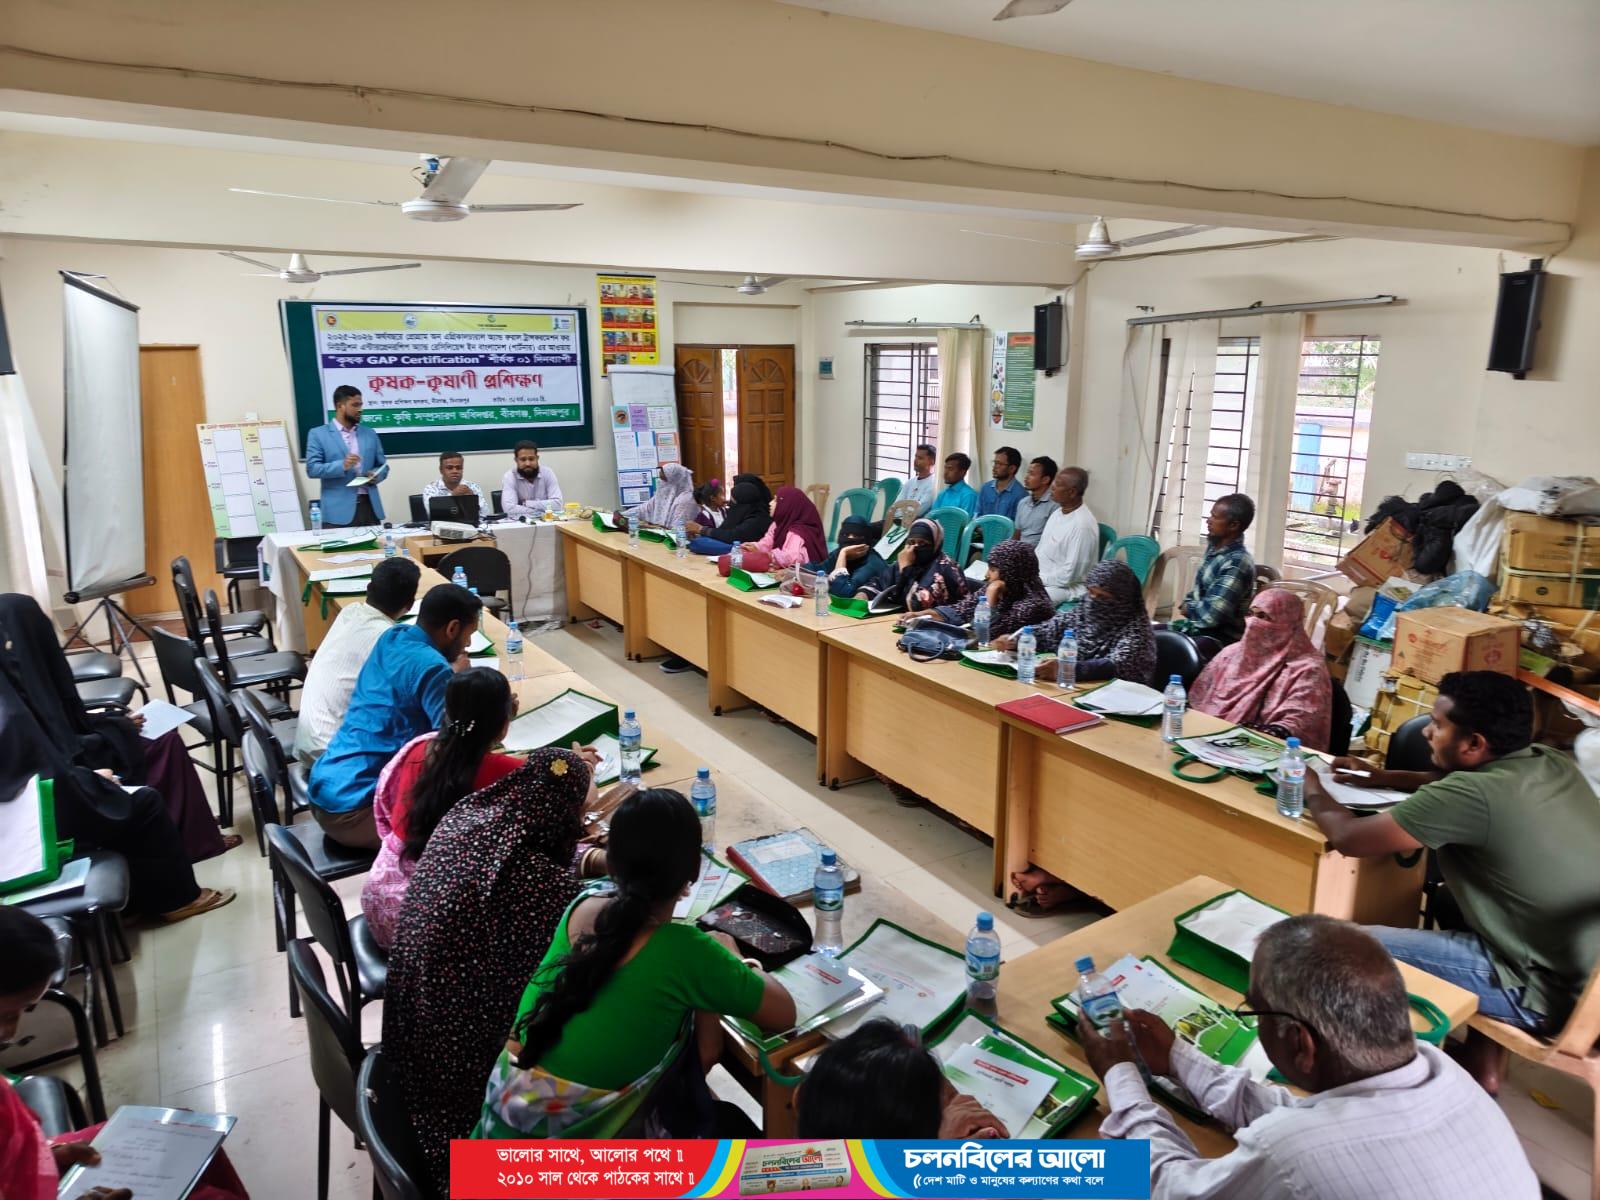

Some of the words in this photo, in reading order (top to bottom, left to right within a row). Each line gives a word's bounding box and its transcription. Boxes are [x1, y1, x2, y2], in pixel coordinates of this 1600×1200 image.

[366, 356, 398, 365] GAP
[367, 369, 478, 396] কৃষক-কৃষাণী
[484, 369, 543, 389] প্রশিক্ষণ
